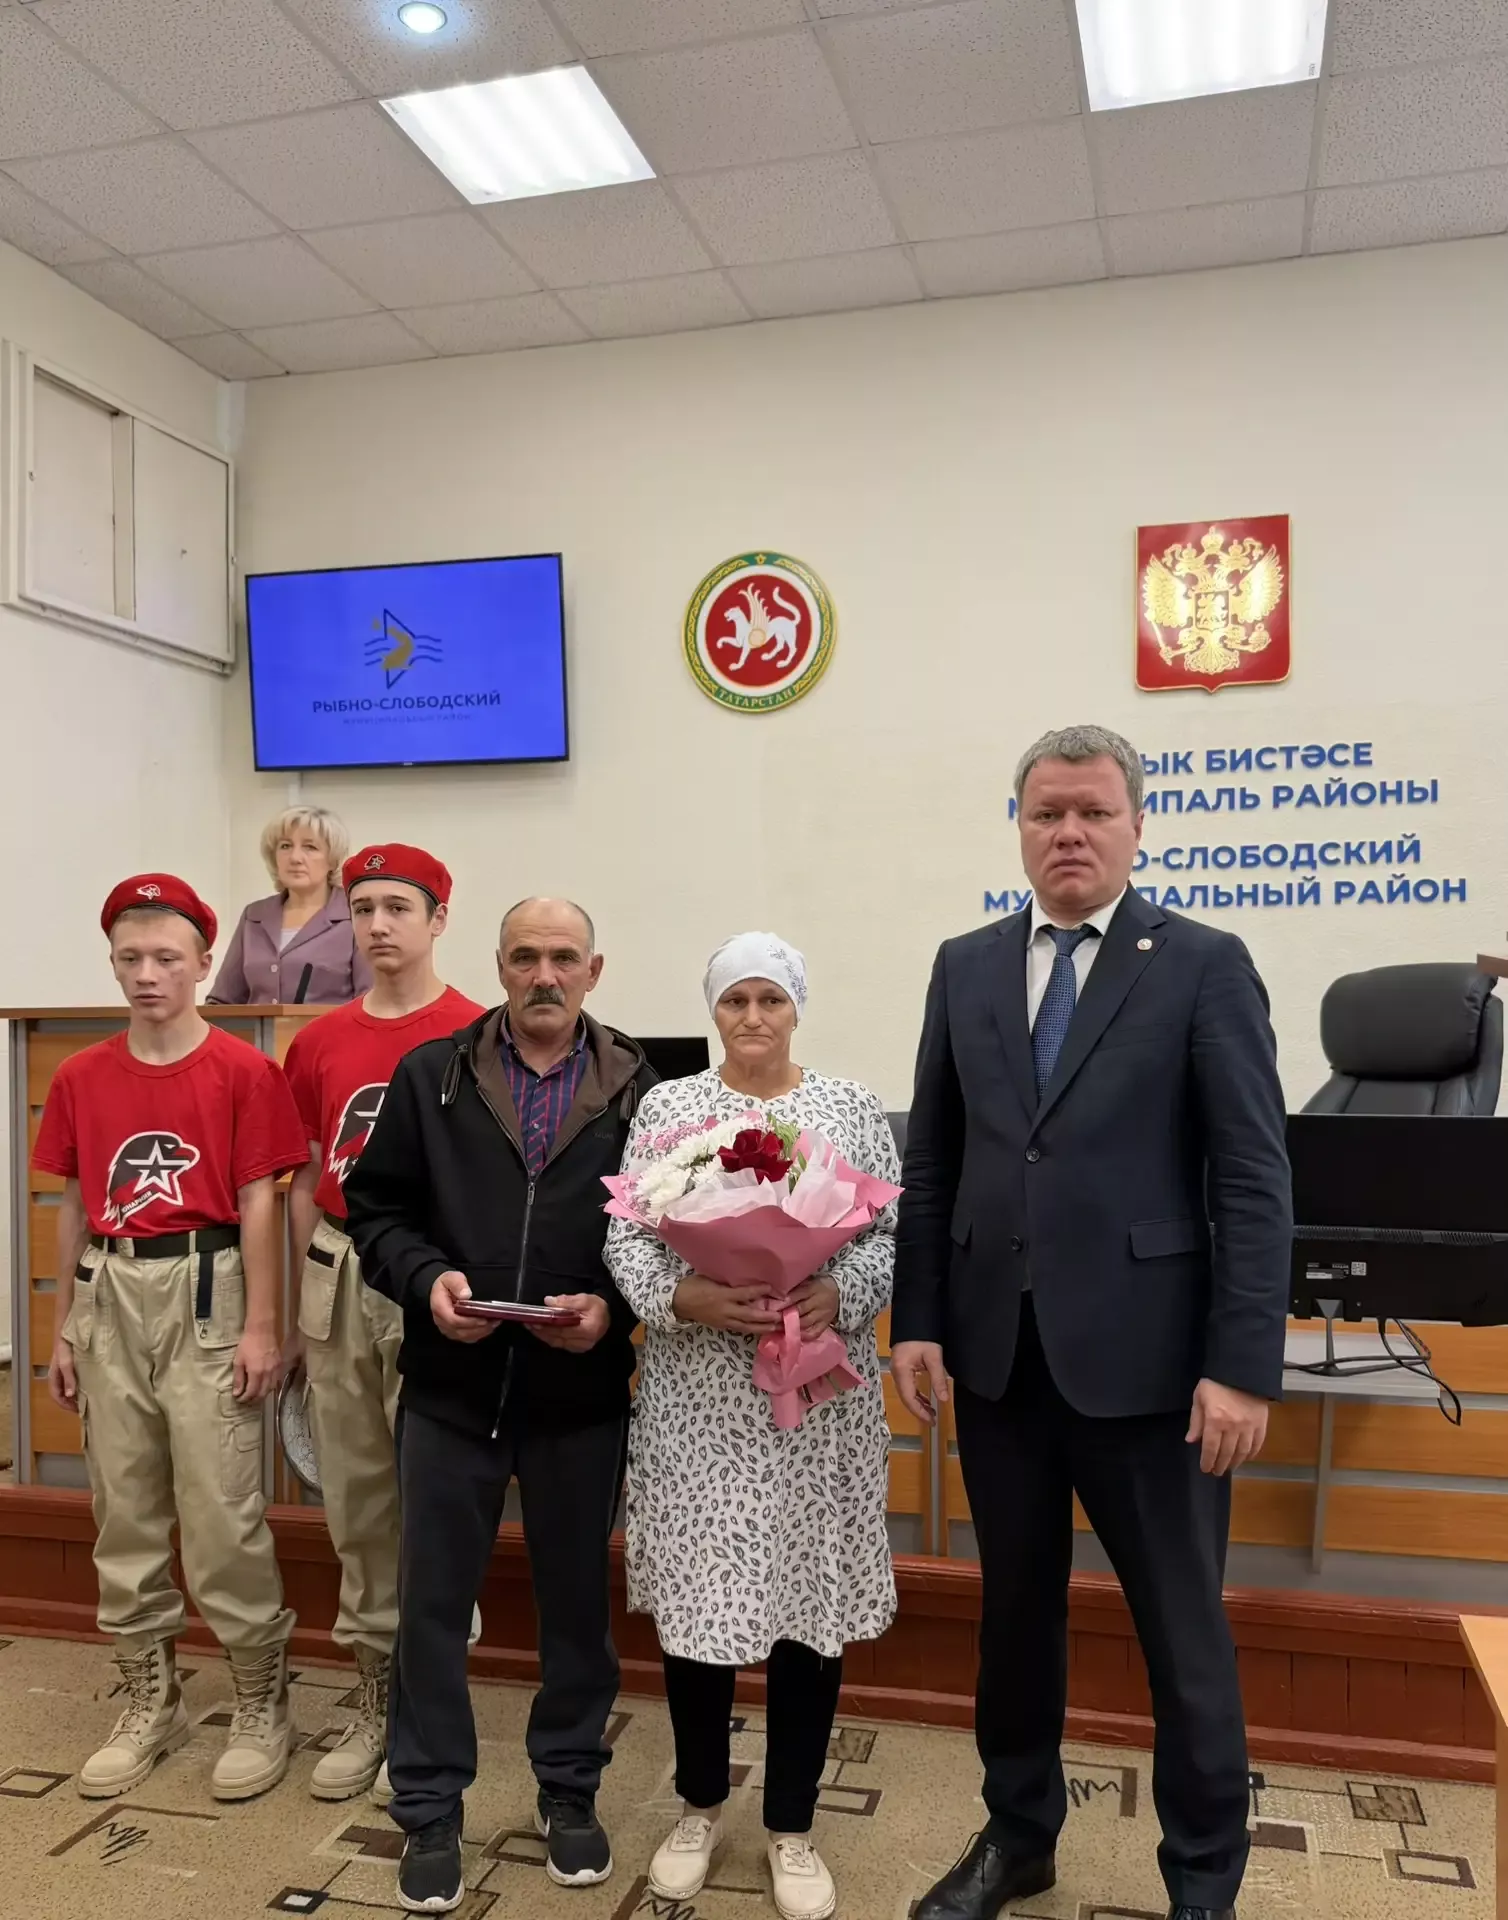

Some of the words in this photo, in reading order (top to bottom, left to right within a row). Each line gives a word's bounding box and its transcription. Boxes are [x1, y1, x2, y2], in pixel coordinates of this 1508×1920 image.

[313, 690, 500, 713] РЫБНО-СЛОБОДСКИЙ
[718, 689, 792, 707] ТАТАРСТАН
[1206, 742, 1373, 773] БИСТӘСЕ
[1272, 777, 1438, 809] РАЙОНЫ
[1132, 833, 1421, 871] О-СЛОБОДСКИЙ
[983, 876, 1321, 912] МУПАЛЬНЫЙ
[1334, 873, 1466, 905] РАЙОН
